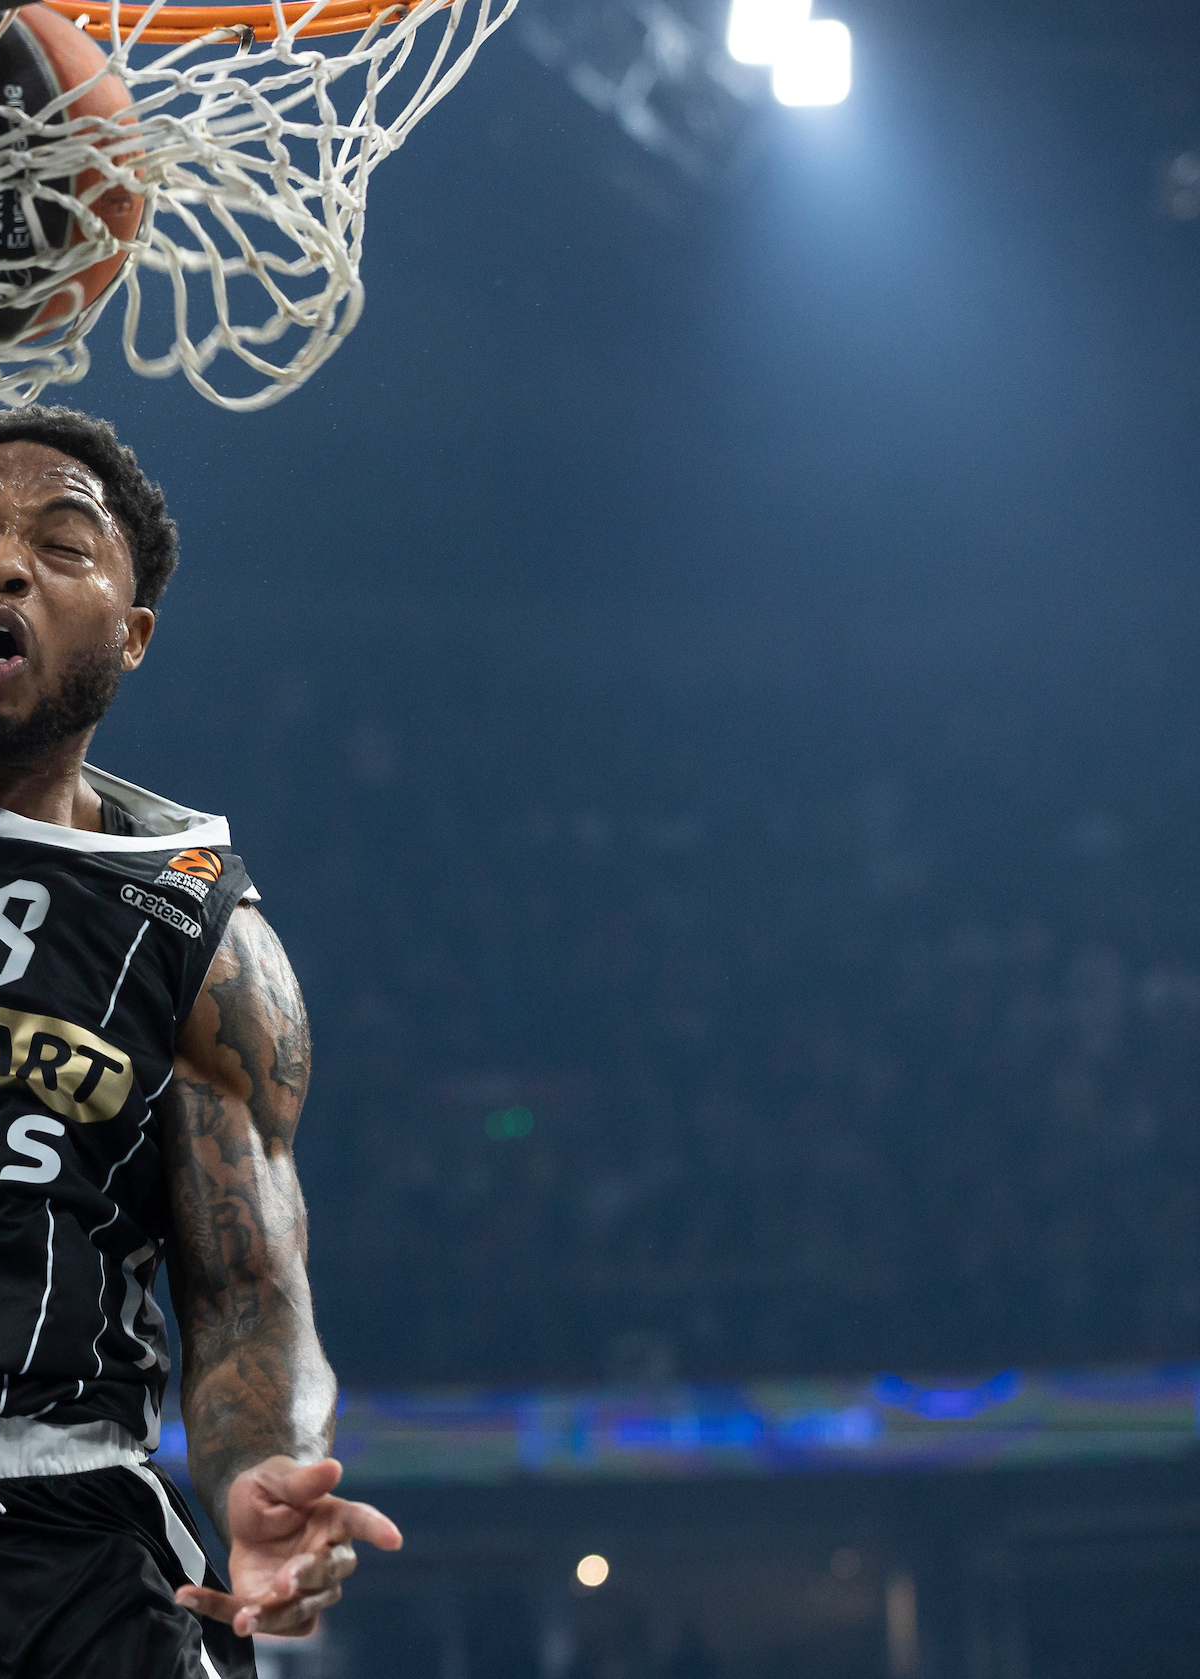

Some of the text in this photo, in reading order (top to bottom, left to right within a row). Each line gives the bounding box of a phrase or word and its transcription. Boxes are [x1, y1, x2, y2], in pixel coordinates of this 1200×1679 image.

[157, 874, 207, 899] AIRLINES
[161, 870, 210, 894] TURKISH
[121, 885, 201, 938] oneteam
